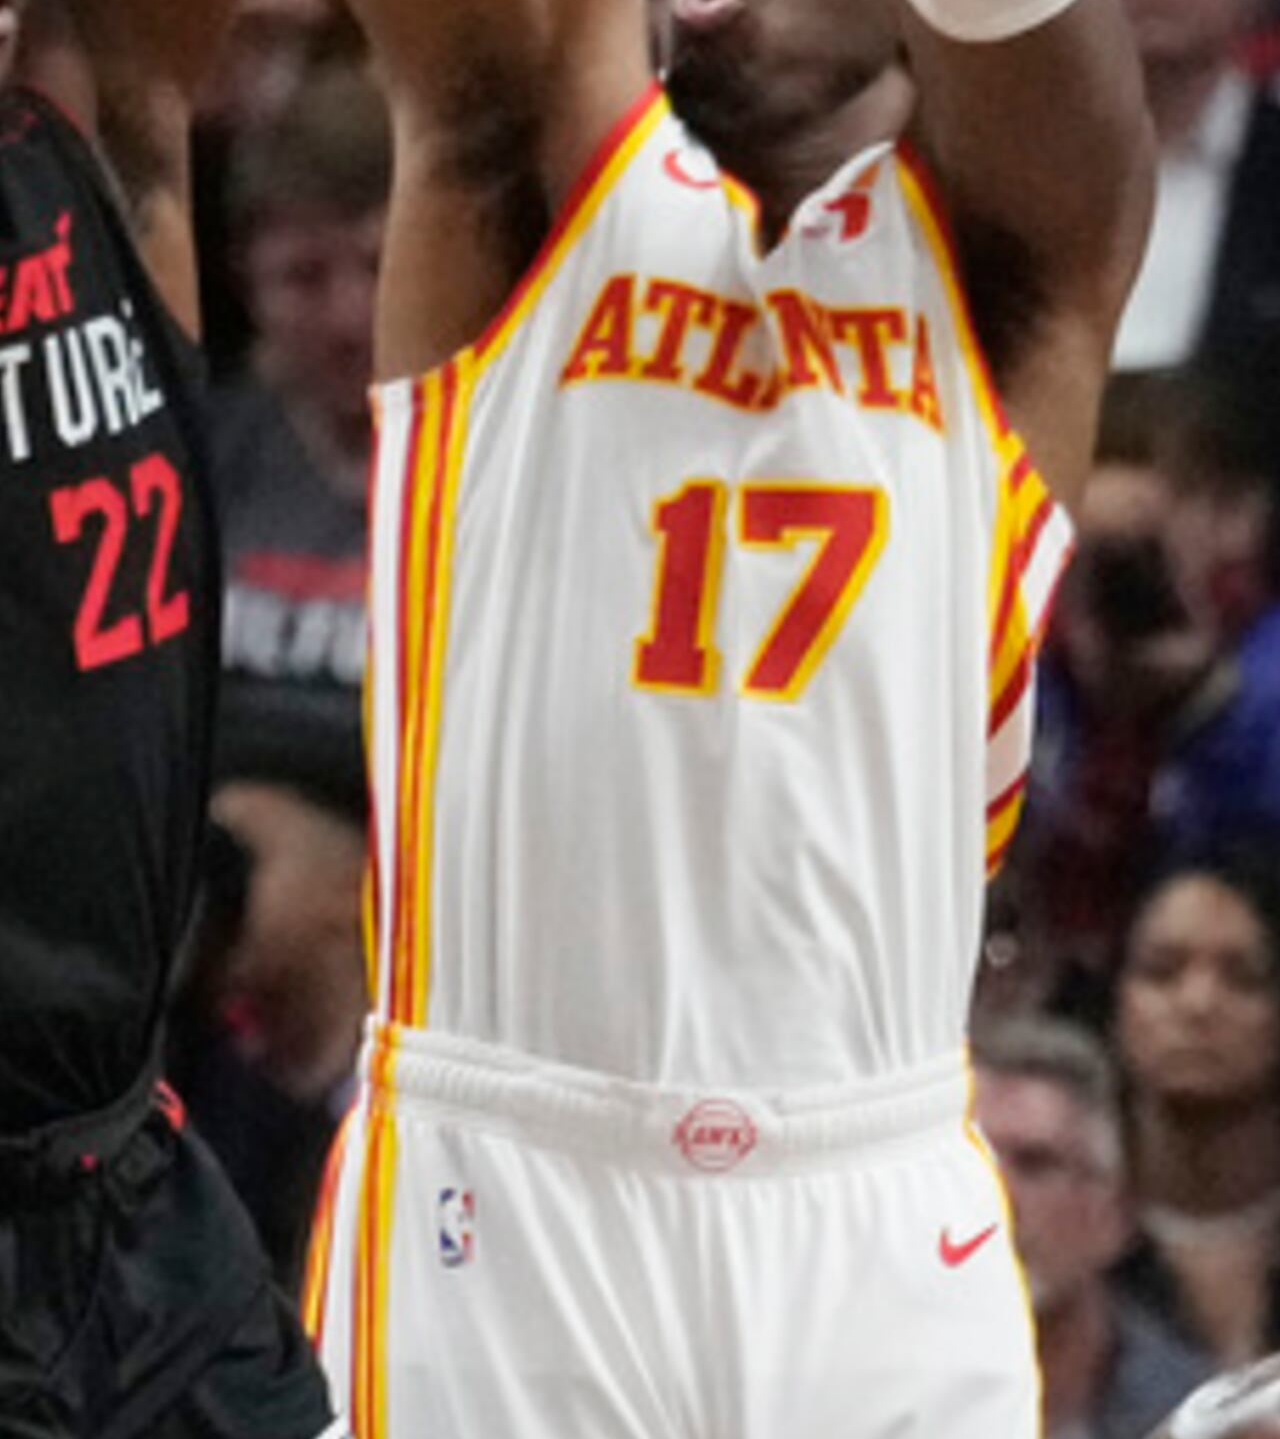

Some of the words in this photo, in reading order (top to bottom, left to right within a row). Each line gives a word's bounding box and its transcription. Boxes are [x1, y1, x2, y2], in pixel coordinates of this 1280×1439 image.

[558, 272, 948, 443] ATLNTA
[49, 453, 190, 671] 22
[632, 478, 891, 702] 17
